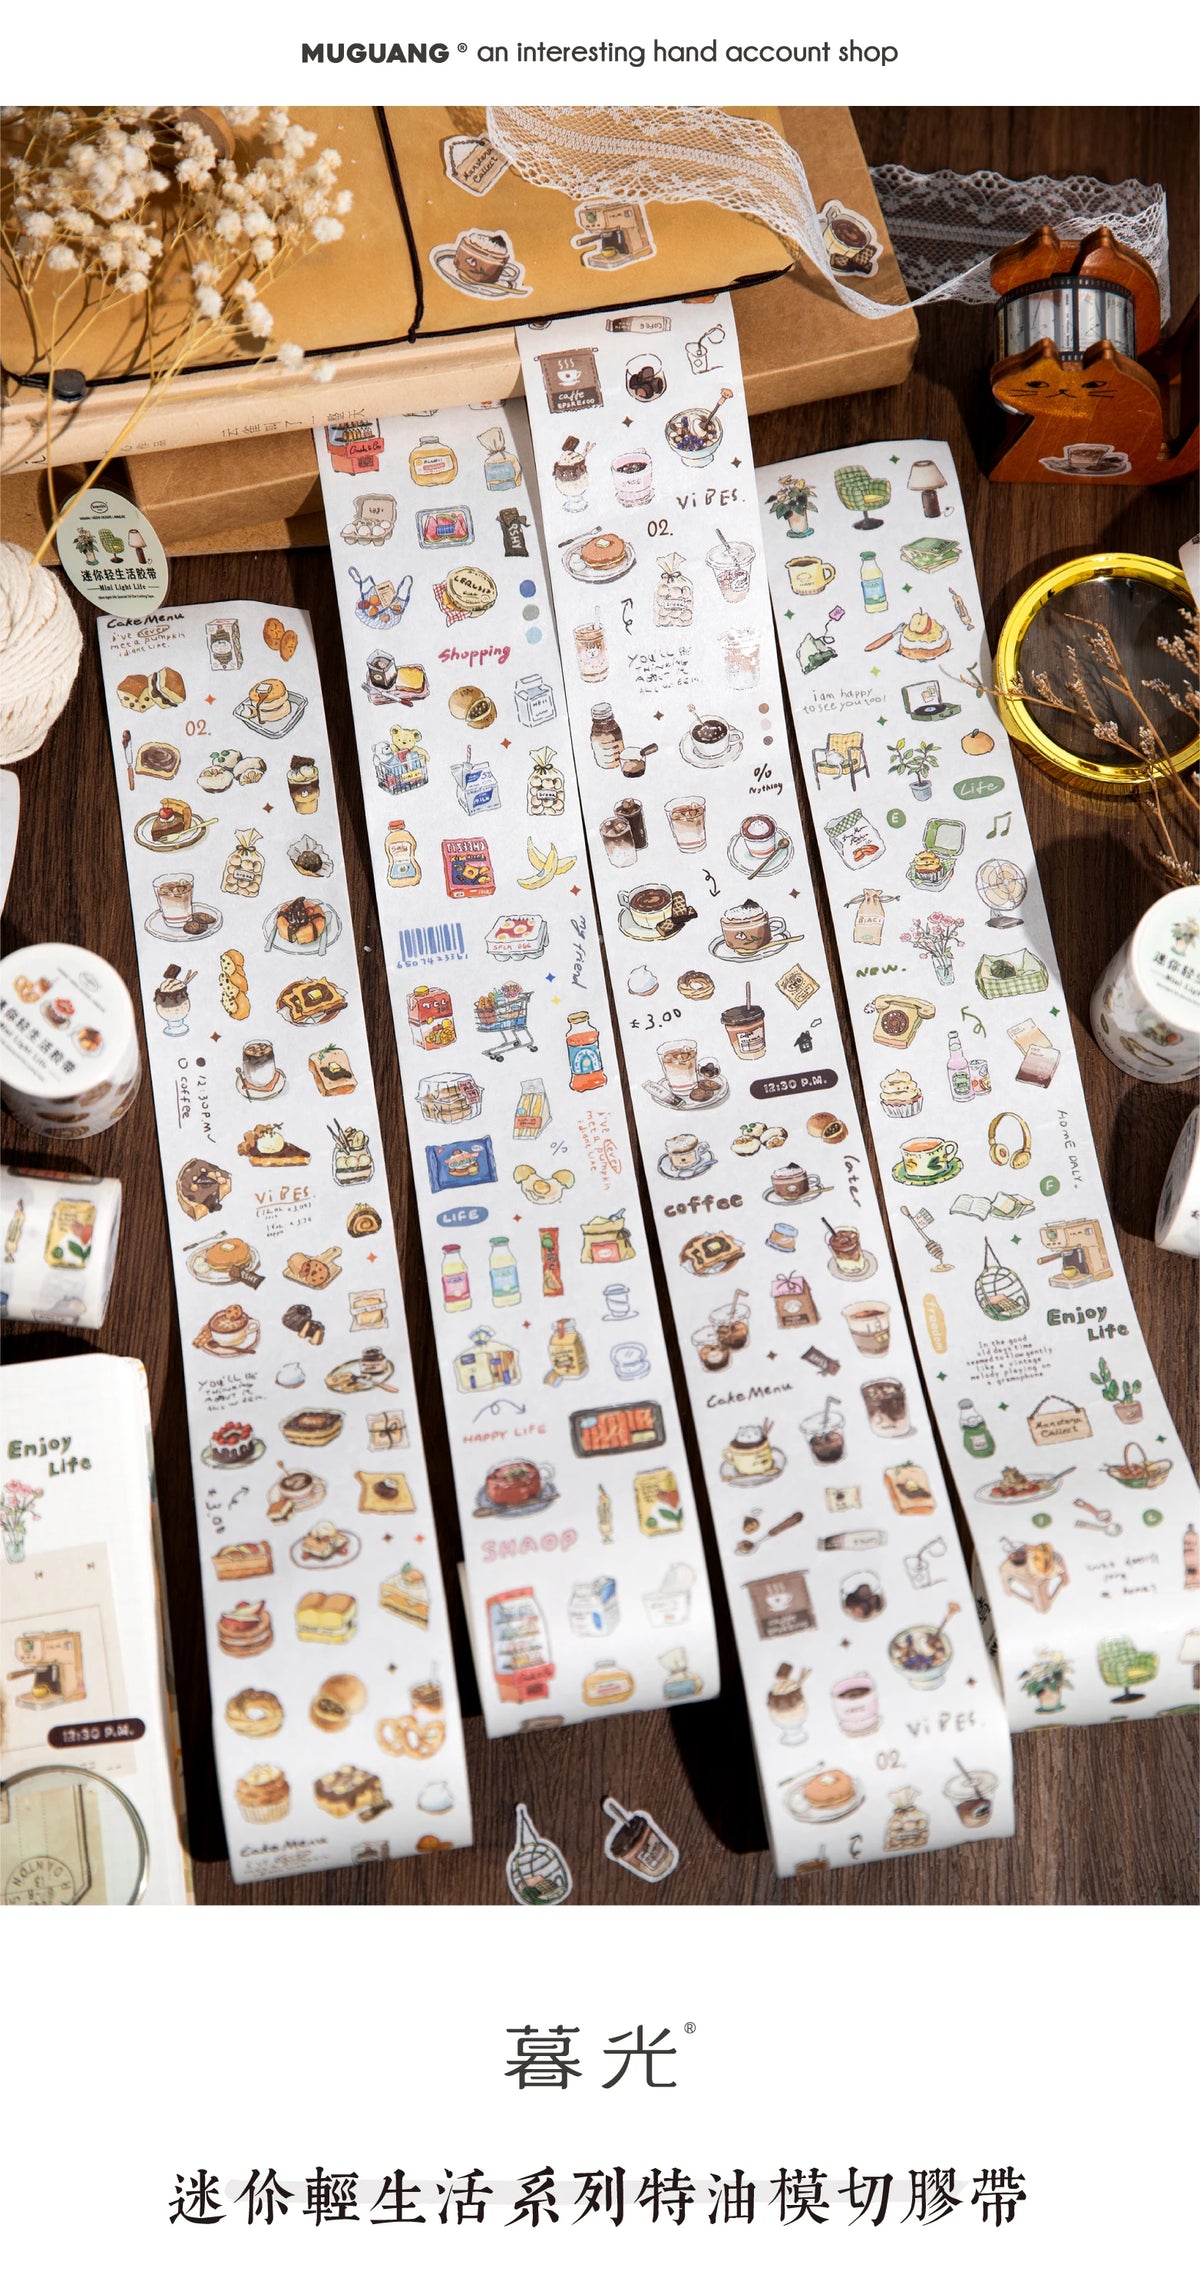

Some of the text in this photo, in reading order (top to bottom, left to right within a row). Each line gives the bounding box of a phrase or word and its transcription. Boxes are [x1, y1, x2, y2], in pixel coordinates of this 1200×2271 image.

[647, 519, 673, 537] 02.
[81, 568, 157, 582] 迷你轻生活胶带
[115, 584, 132, 592] Light
[107, 612, 185, 629] Cake Menu
[438, 645, 511, 667] Shopping
[840, 688, 873, 699] happy
[818, 702, 837, 712] see
[839, 700, 862, 712] you
[185, 719, 212, 737] 02.
[960, 780, 998, 796] Life
[890, 812, 899, 823] E
[570, 915, 588, 989] my friend
[763, 1075, 827, 1094] 12:30 P.M.
[180, 1076, 191, 1119] coffee
[844, 1155, 862, 1207] later
[664, 1194, 744, 1218] coffee
[441, 1210, 480, 1224] LIFE
[1046, 1305, 1108, 1327] Enjoy
[1008, 1334, 1028, 1346] good
[1087, 1323, 1130, 1342] Life
[1025, 1345, 1053, 1358] gently
[1009, 1357, 1042, 1366] vintage
[970, 1370, 999, 1380] melody
[1003, 1366, 1038, 1377] playing
[706, 1382, 794, 1409] Cake Menu
[462, 1424, 547, 1445] HAPPY LIFE
[7, 1436, 72, 1460] Enjoy
[48, 1456, 92, 1478] Life
[62, 1728, 100, 1743] 12:30
